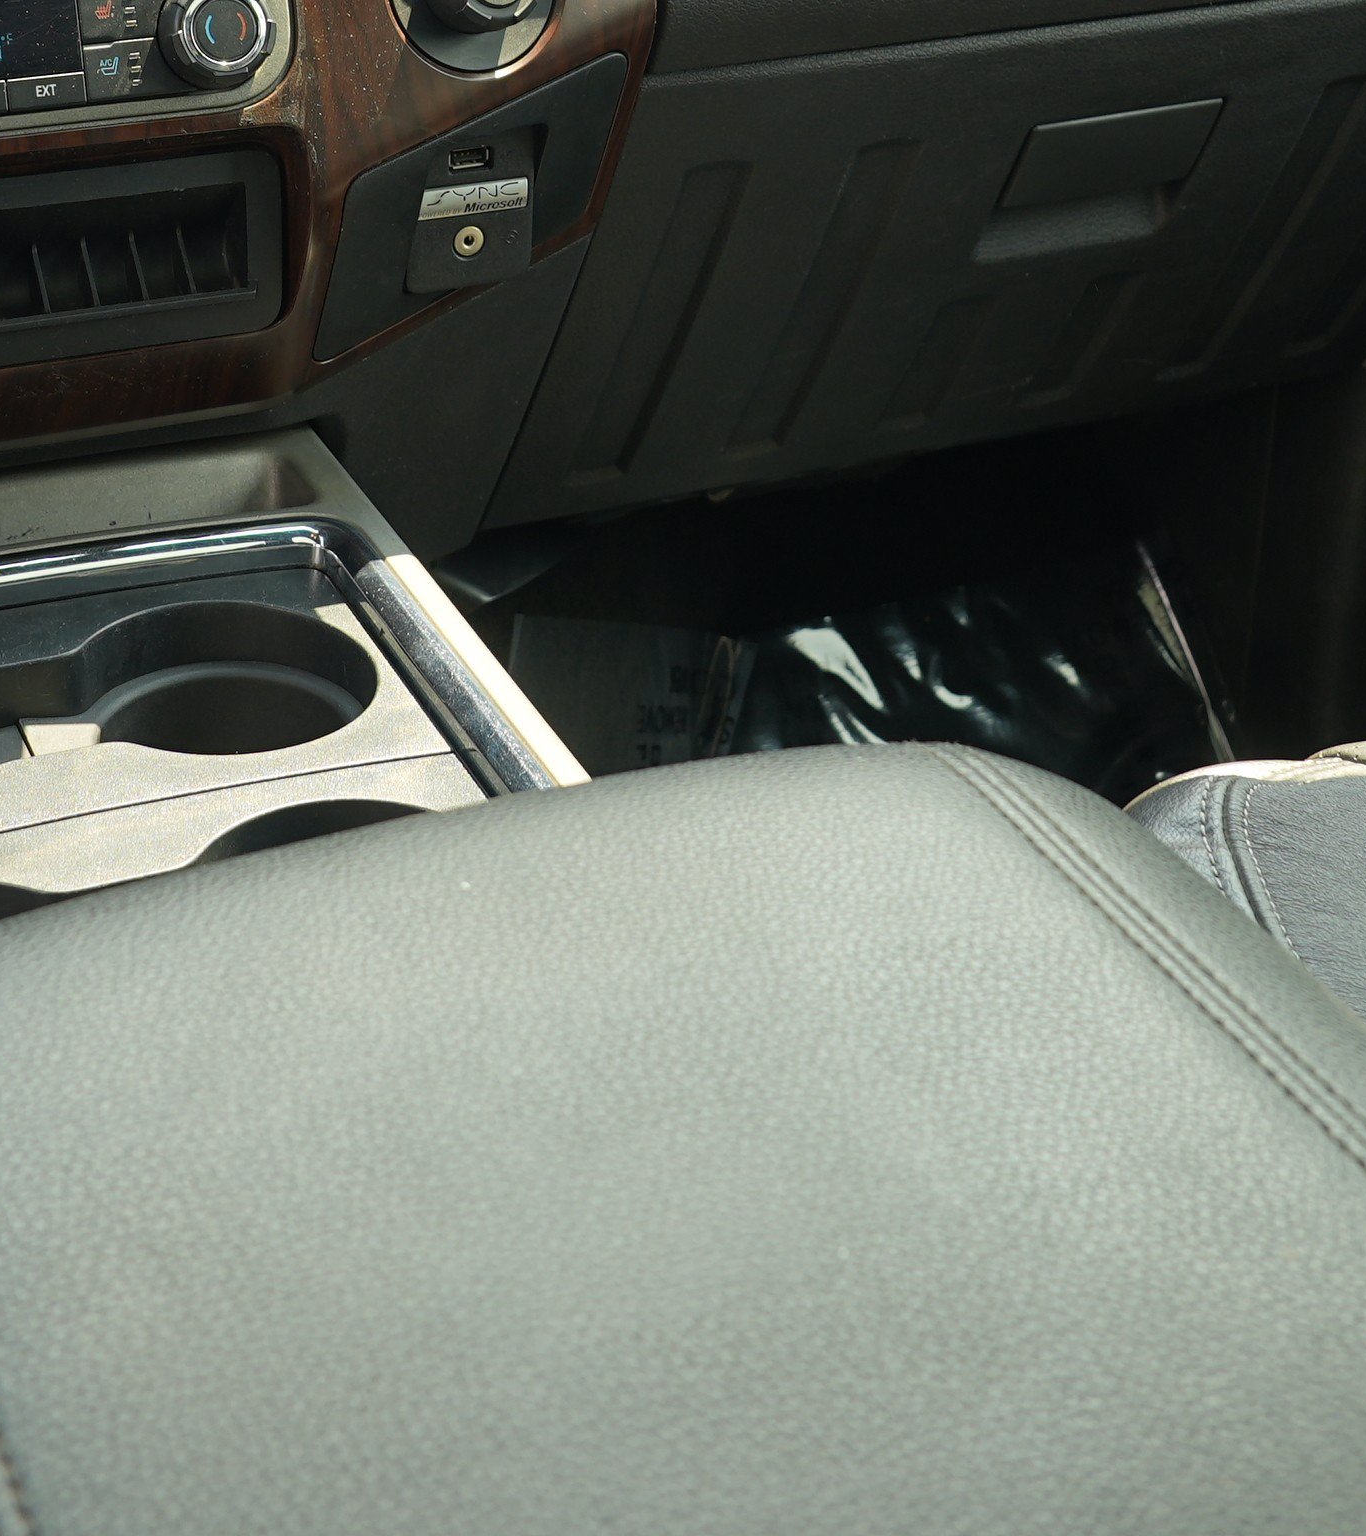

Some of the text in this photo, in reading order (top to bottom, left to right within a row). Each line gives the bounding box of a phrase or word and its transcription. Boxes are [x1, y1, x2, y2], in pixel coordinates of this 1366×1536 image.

[99, 58, 112, 68] A/C
[35, 84, 57, 98] EXT
[427, 181, 519, 206] SYNC
[453, 208, 463, 216] BY
[464, 197, 524, 213] Microsoft
